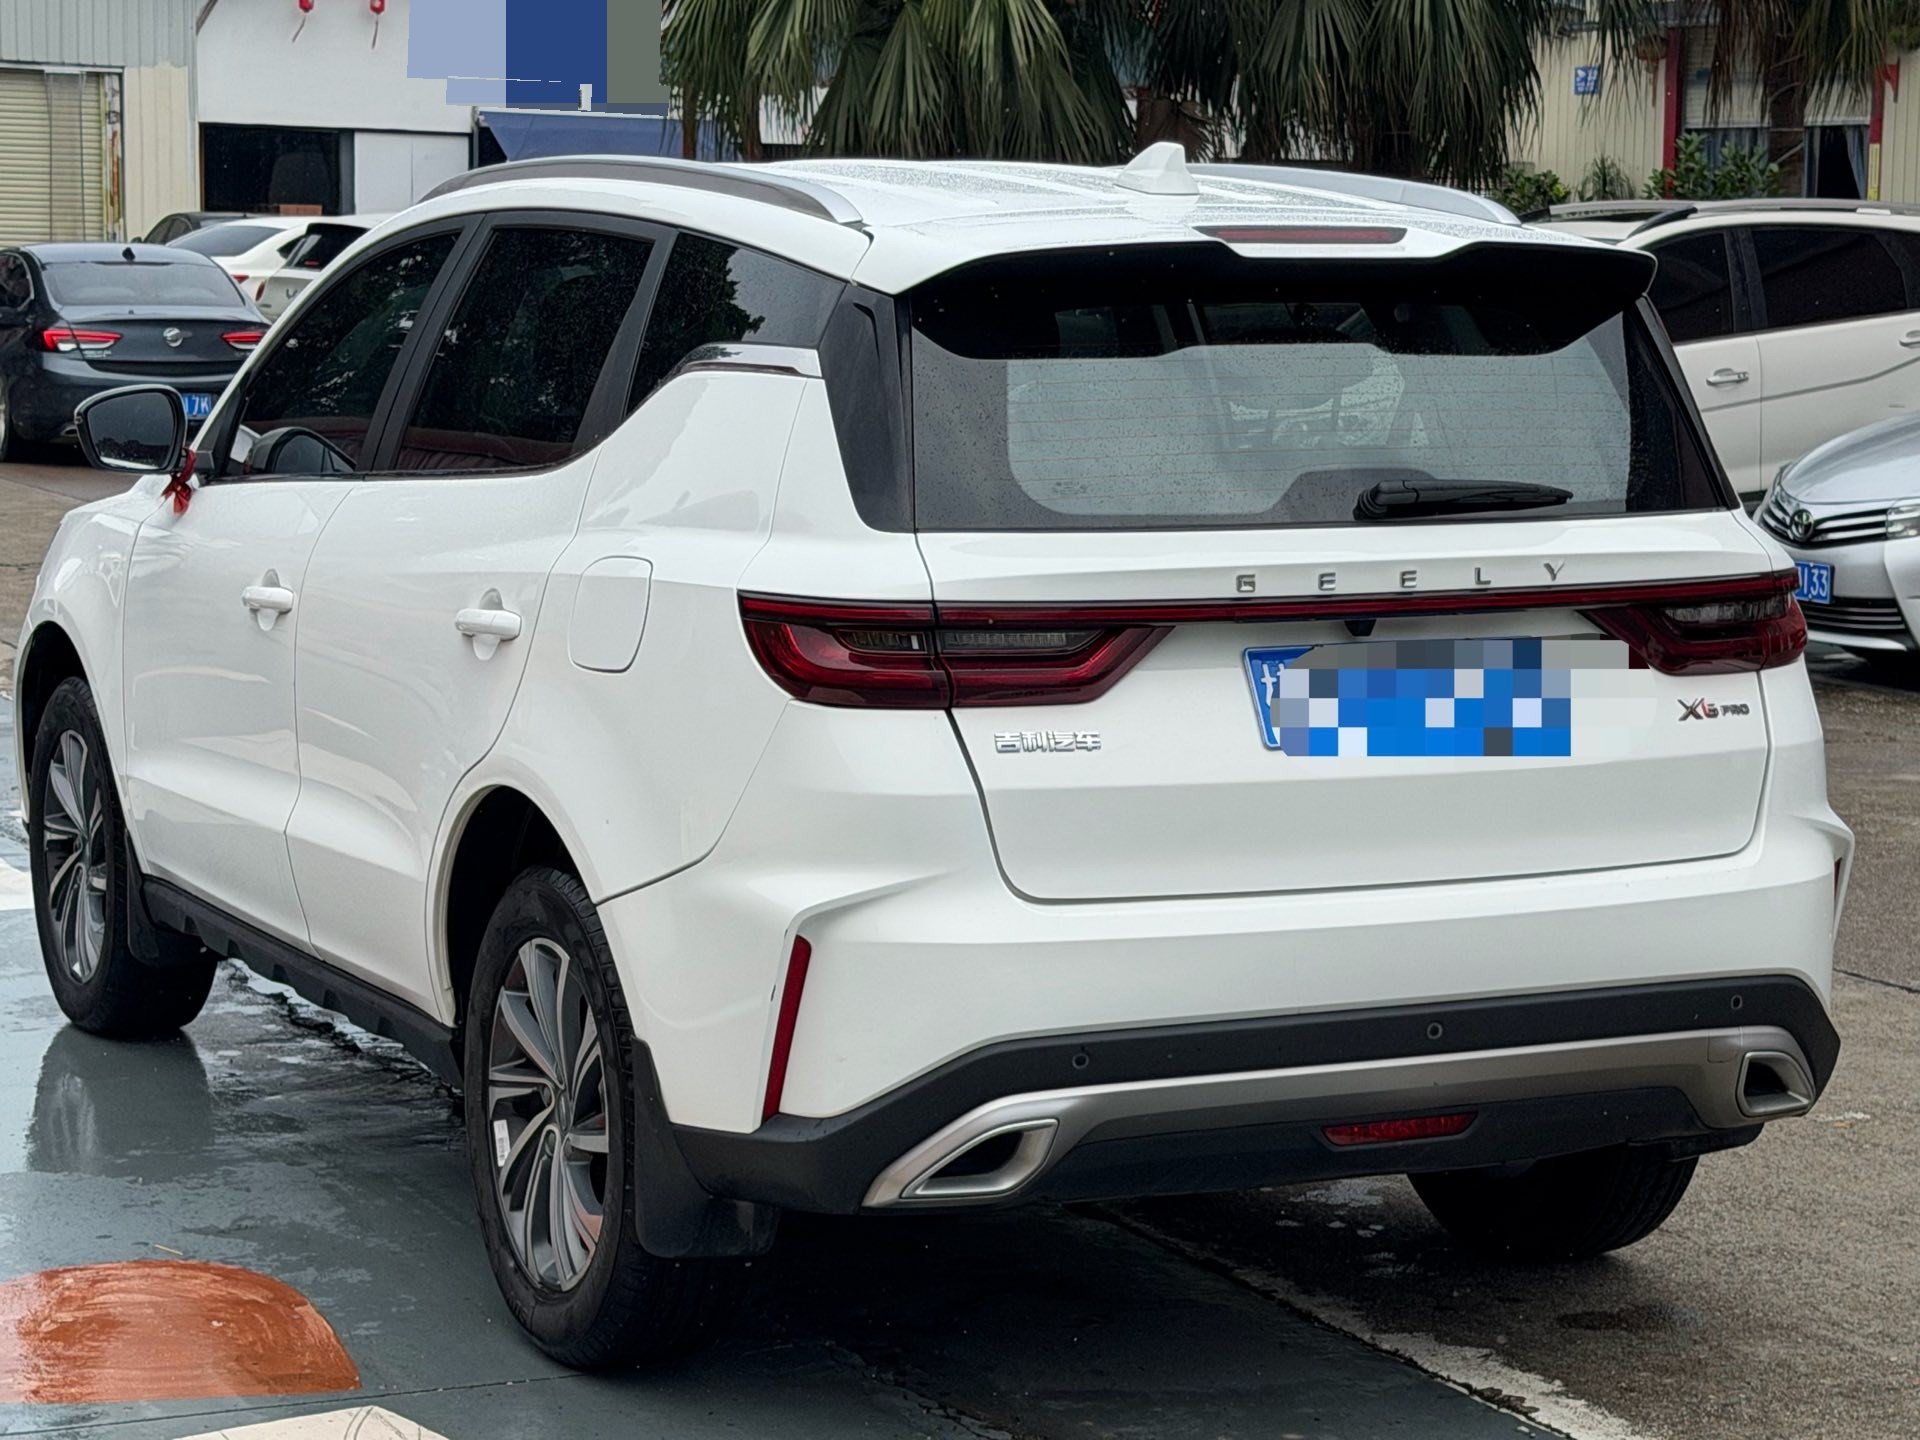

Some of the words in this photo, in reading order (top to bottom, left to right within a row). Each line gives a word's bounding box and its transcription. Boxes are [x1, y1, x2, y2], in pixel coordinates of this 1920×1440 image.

[1236, 561, 1565, 594] GEELY
[1720, 703, 1750, 716] PRO
[994, 731, 1101, 754] 吉利汽车
